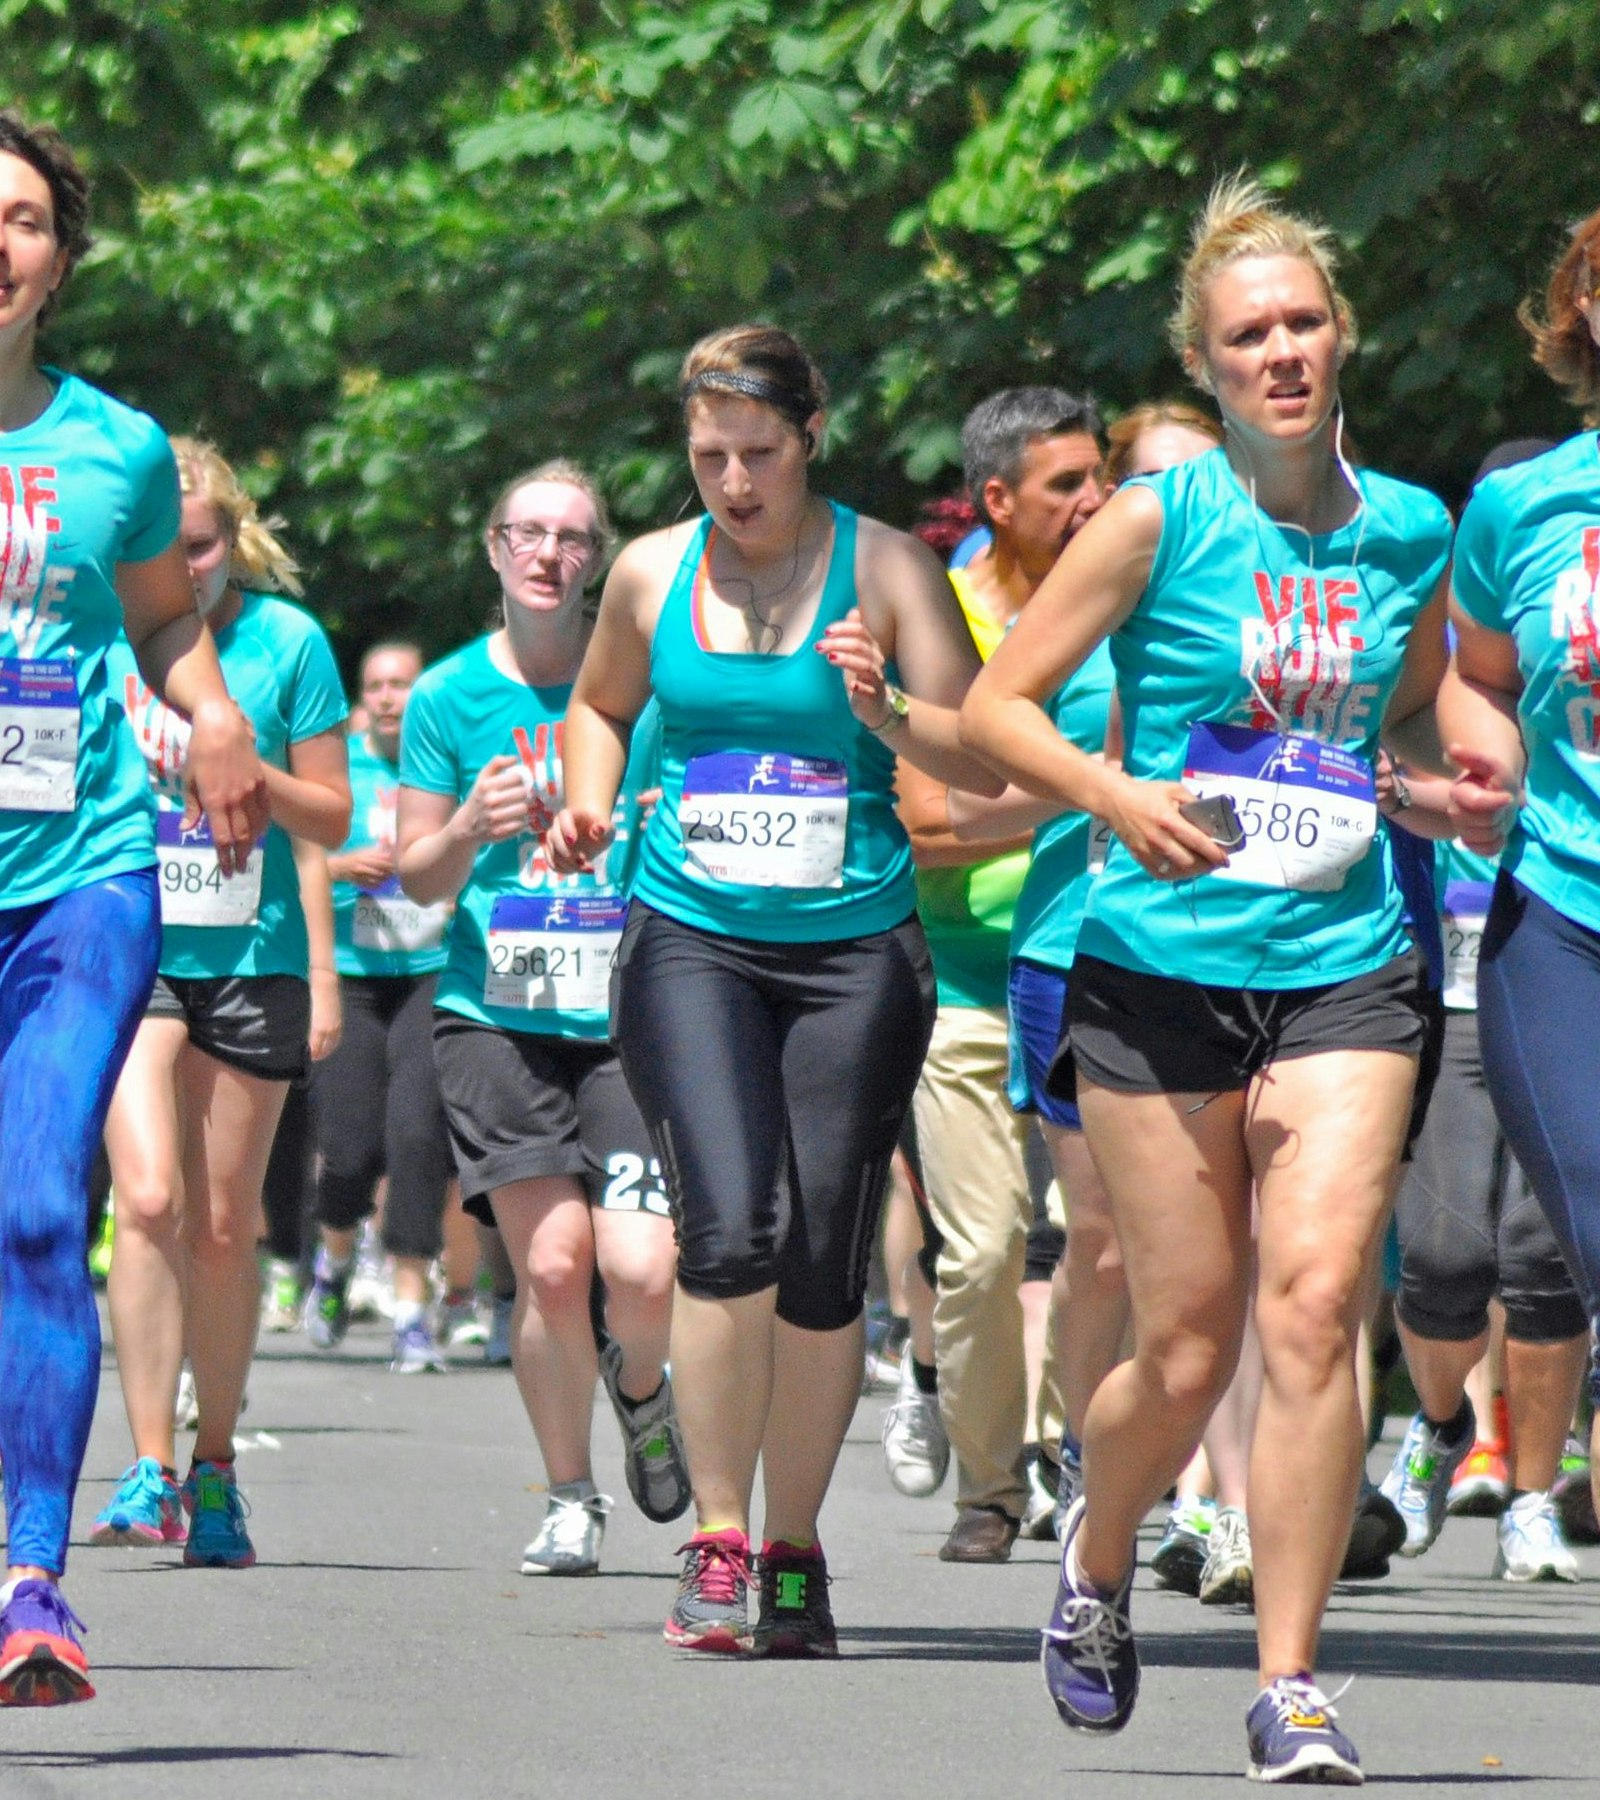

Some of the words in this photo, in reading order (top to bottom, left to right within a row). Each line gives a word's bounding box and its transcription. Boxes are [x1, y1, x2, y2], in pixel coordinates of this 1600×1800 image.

[1253, 571, 1364, 651] VIE
[1240, 617, 1353, 683] RUN
[34, 728, 66, 742] 10K-F
[687, 810, 797, 848] 23532
[1242, 797, 1320, 849] 586
[164, 861, 223, 895] 984
[492, 944, 581, 978] 25621
